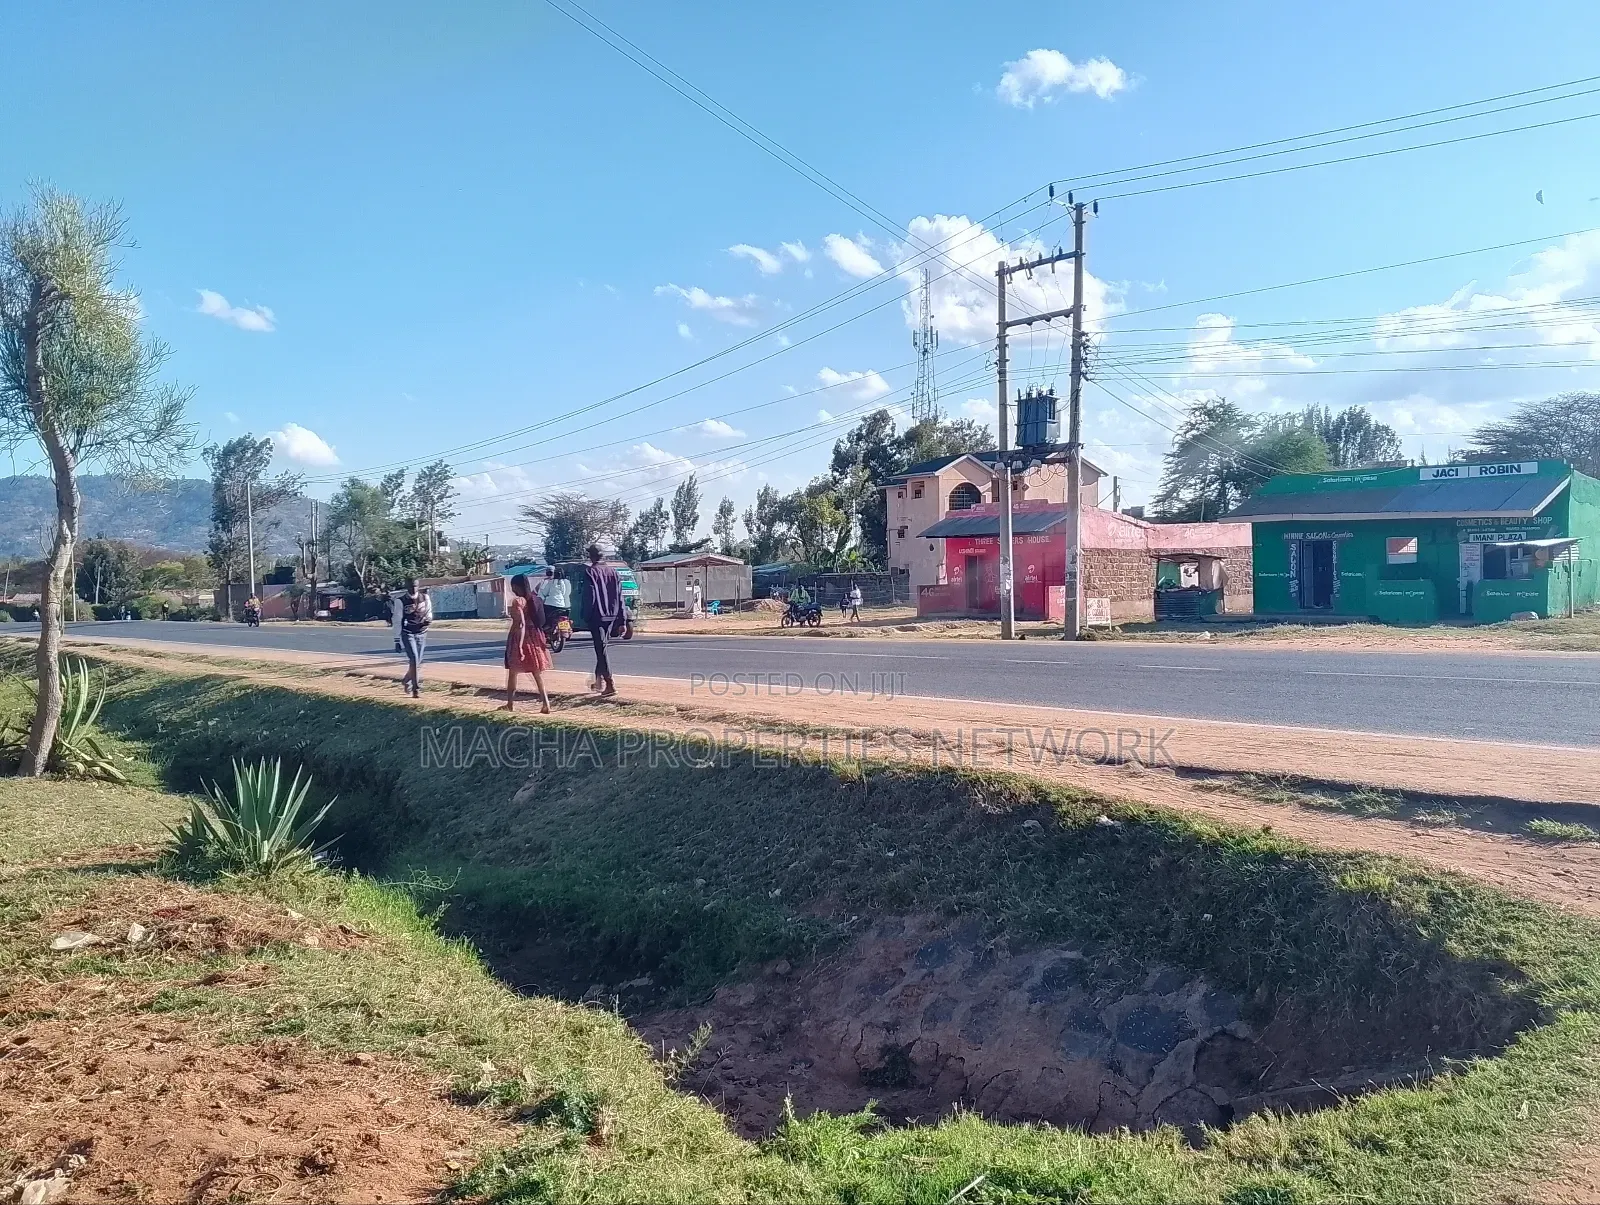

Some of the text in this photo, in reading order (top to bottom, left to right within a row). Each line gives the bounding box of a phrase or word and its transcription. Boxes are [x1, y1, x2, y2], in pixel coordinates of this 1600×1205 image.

[1432, 464, 1522, 478] JACI ROBIN
[1456, 518, 1493, 527] COSMETICS
[1500, 517, 1529, 526] BEAUTY
[1533, 516, 1553, 525] SHOP
[1118, 524, 1145, 537] airtel
[1473, 533, 1523, 542] IMANI PLAZA
[920, 587, 935, 597] 4G
